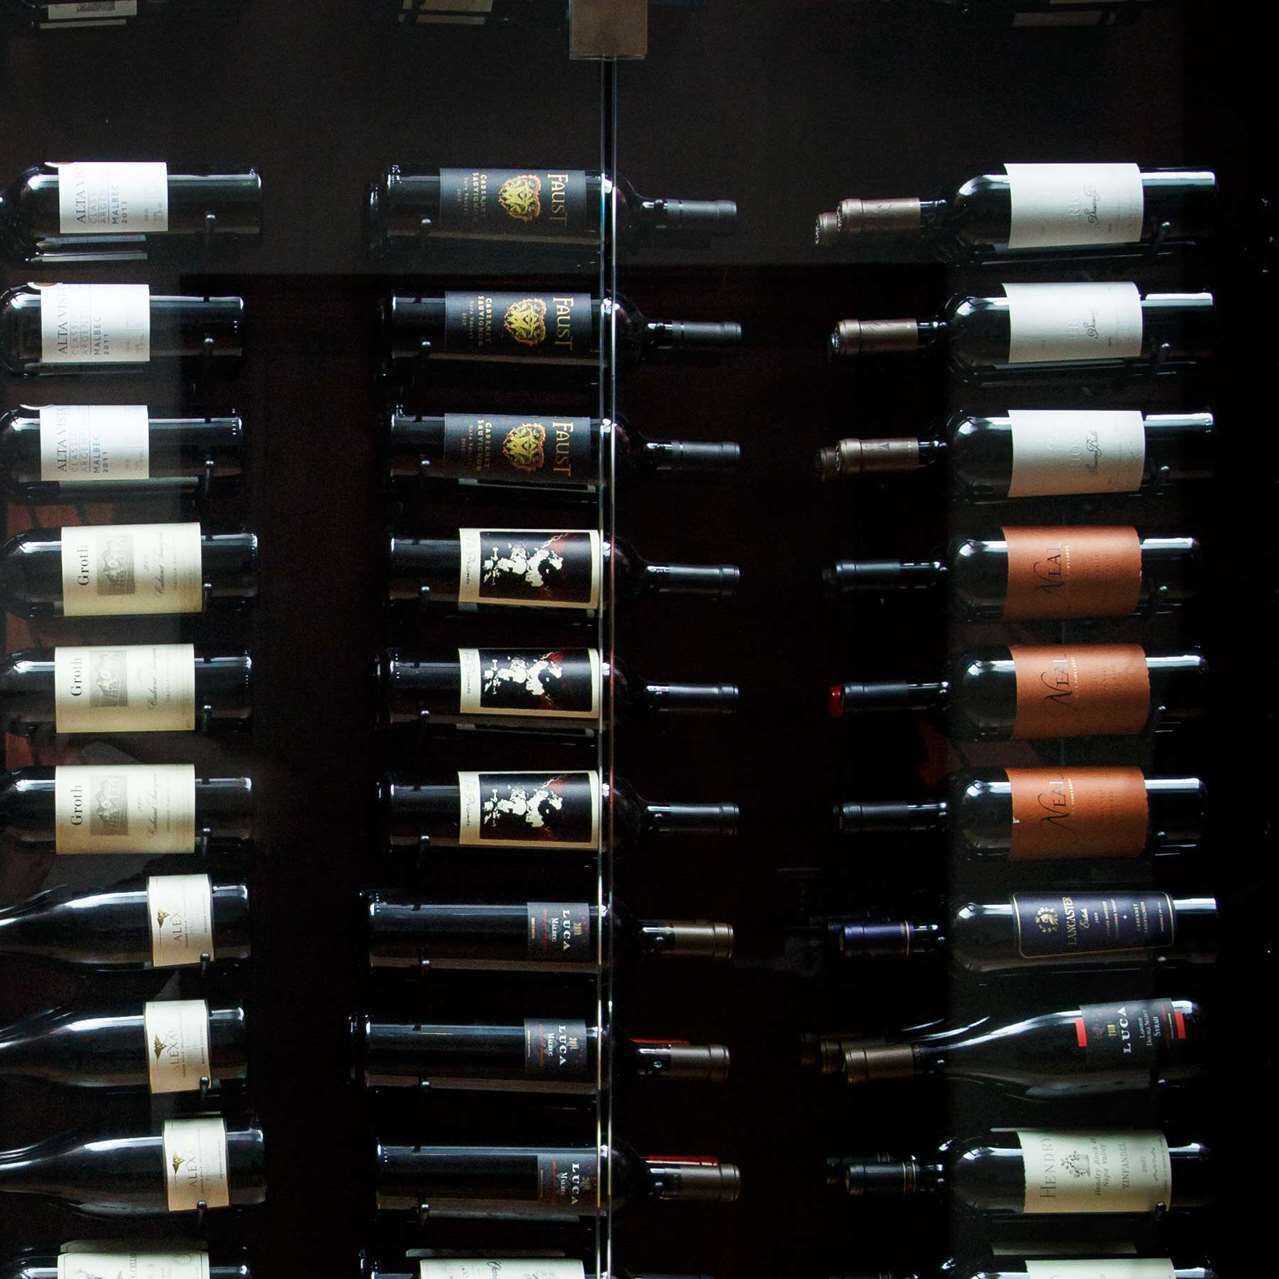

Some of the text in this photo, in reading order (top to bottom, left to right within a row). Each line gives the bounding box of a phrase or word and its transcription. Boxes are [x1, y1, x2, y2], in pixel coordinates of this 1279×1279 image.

[74, 190, 88, 225] ALTA
[111, 184, 121, 225] MALBEC
[120, 200, 128, 225] 2011
[547, 172, 569, 225] FAUST
[55, 321, 69, 357] ALTA
[92, 316, 102, 357] MALBEC
[484, 297, 493, 344] CABERNET
[552, 296, 575, 352] FAUST
[101, 332, 110, 357] 2011
[55, 439, 68, 474] ALTA
[92, 436, 102, 474] MALBEC
[101, 450, 110, 474] 2011
[551, 420, 574, 477] FAUST
[76, 543, 90, 587] Groth
[70, 656, 84, 698] Groth
[69, 784, 83, 827] Groth
[562, 909, 572, 951] LUCA
[1062, 896, 1078, 947] LANCASTER
[558, 1025, 568, 1066] LUCA
[1117, 1006, 1134, 1055] LUCA
[1152, 1015, 1162, 1038] SYRAH
[571, 1162, 580, 1206] LUCA
[1039, 1136, 1058, 1200] HENDRY
